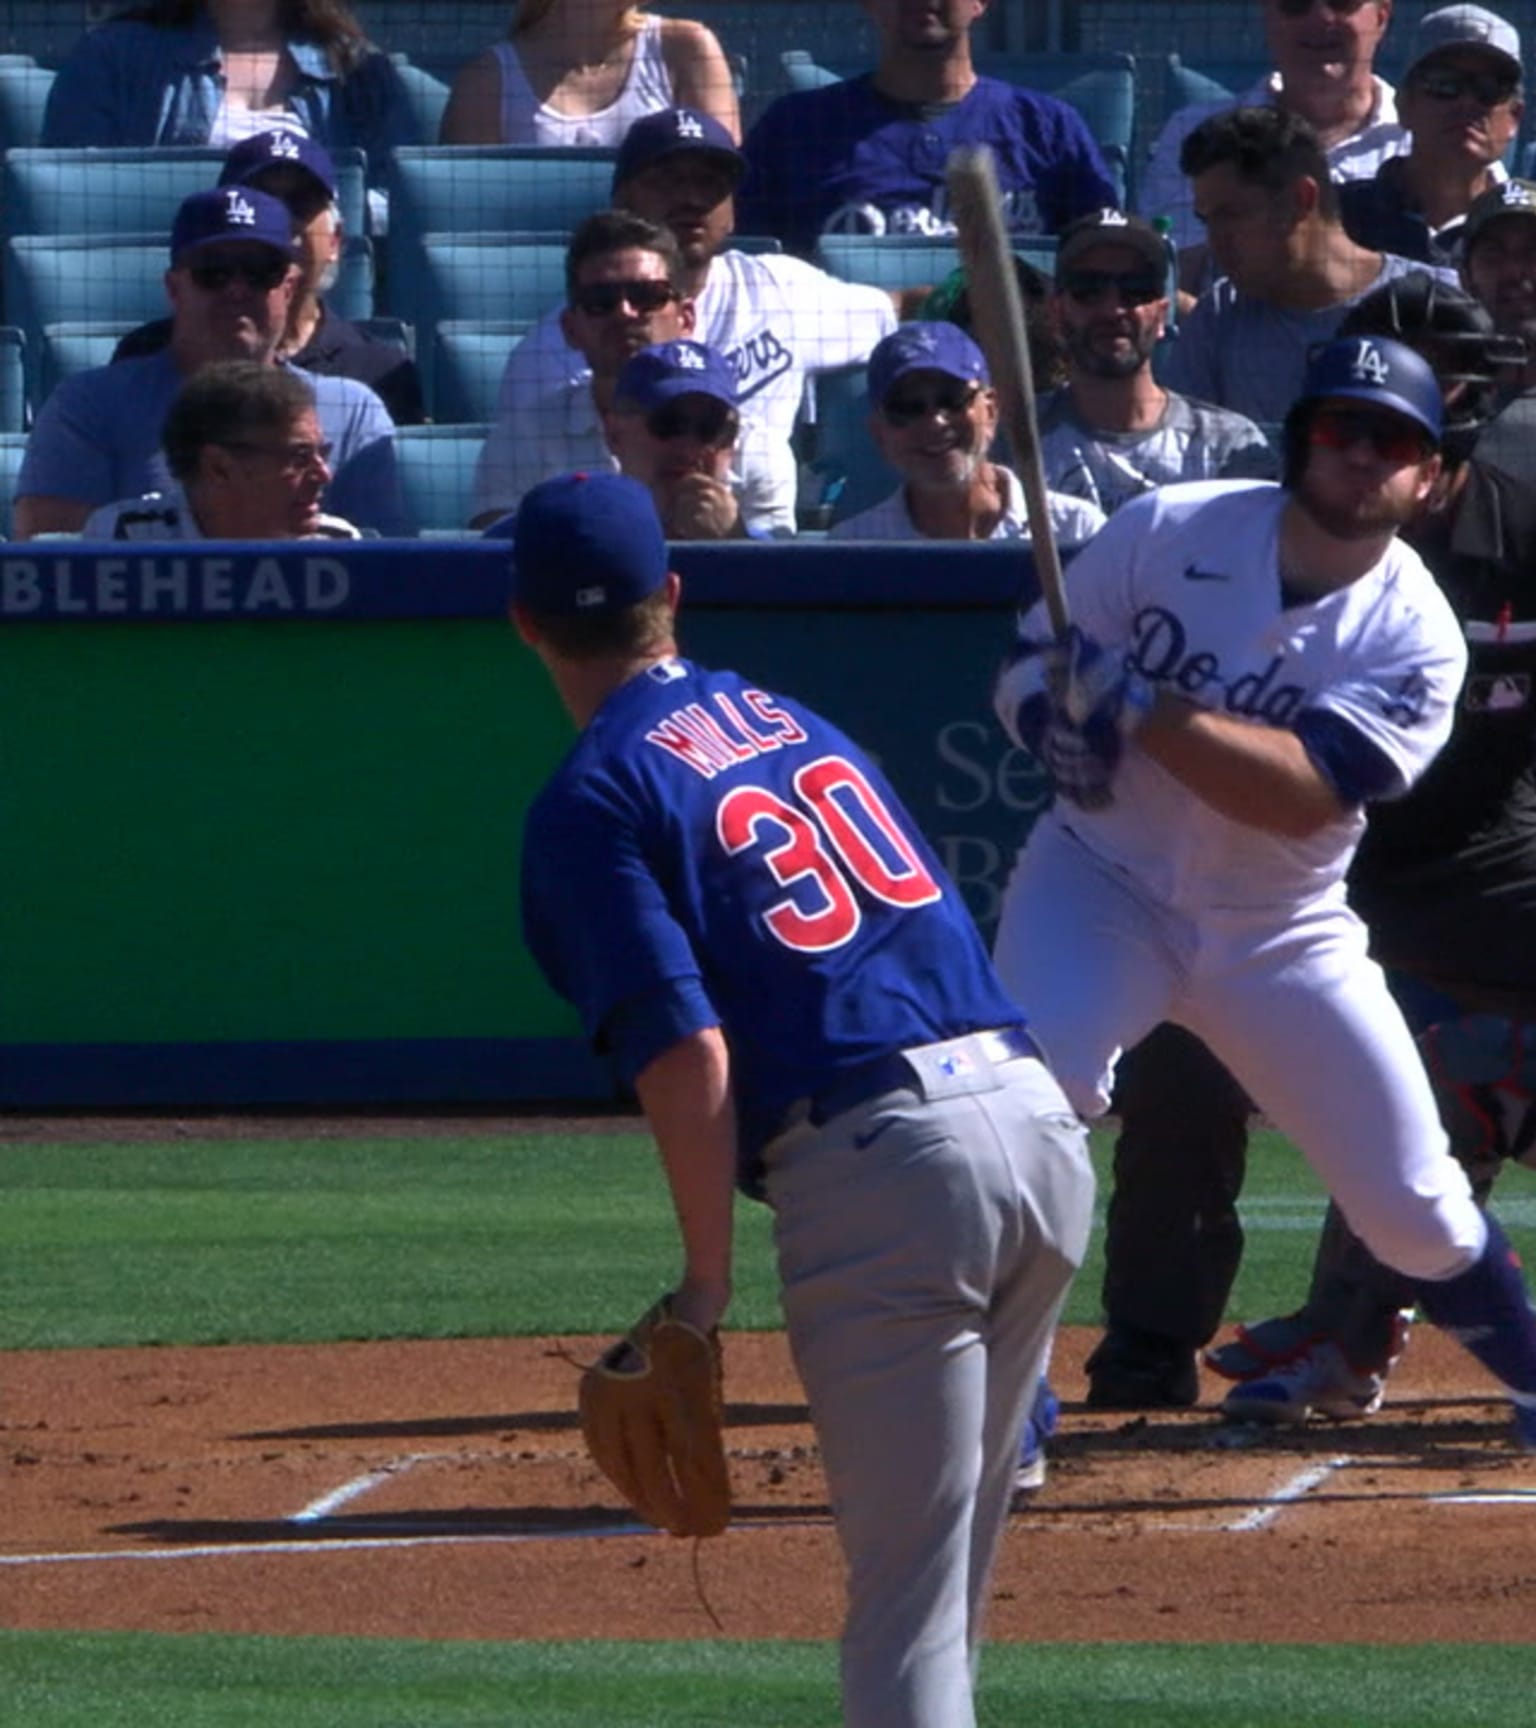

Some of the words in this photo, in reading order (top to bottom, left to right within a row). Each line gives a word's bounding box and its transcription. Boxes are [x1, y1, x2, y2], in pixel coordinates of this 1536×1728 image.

[676, 109, 704, 138] LA
[269, 131, 300, 159] LA
[226, 191, 256, 225] LA
[677, 345, 705, 370] LA
[1353, 339, 1390, 384] LA
[3, 557, 350, 612] BLEHEAD
[645, 690, 808, 779] MILLS
[716, 755, 942, 952] 30
